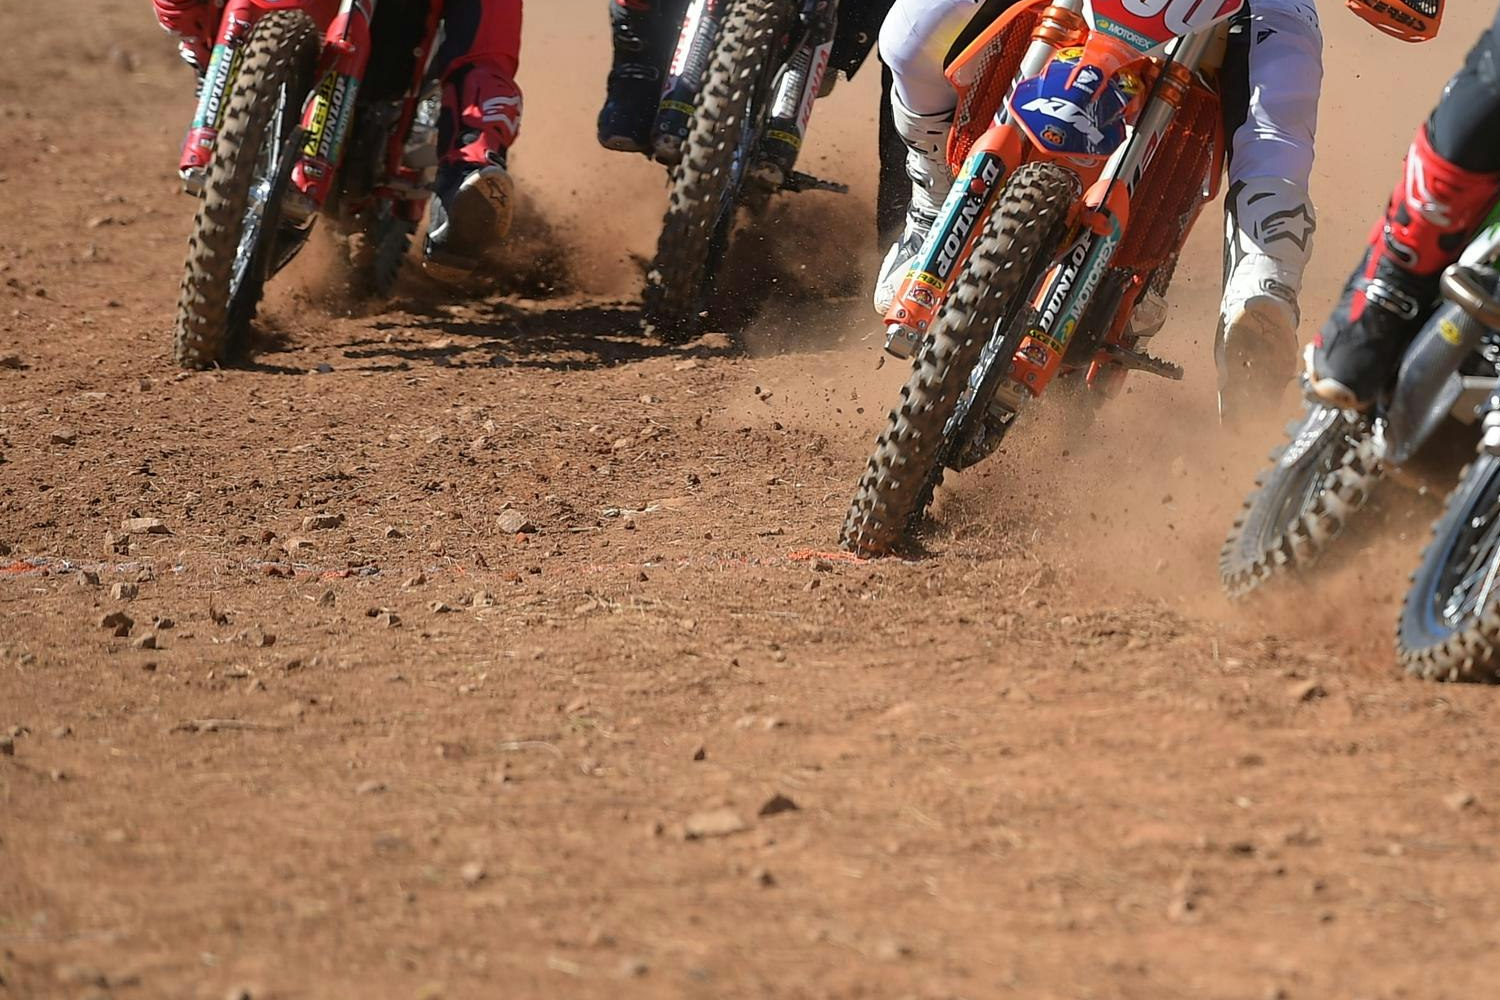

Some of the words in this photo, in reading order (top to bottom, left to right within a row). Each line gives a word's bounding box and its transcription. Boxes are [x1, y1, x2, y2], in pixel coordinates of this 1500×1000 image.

[1107, 23, 1151, 49] MOTOREX
[206, 46, 234, 125] DUNLOP
[318, 77, 348, 159] DUNLOP
[936, 159, 1000, 278] DNLOP
[1039, 225, 1093, 335] DUNLOP
[1070, 236, 1119, 320] MOTOREX
